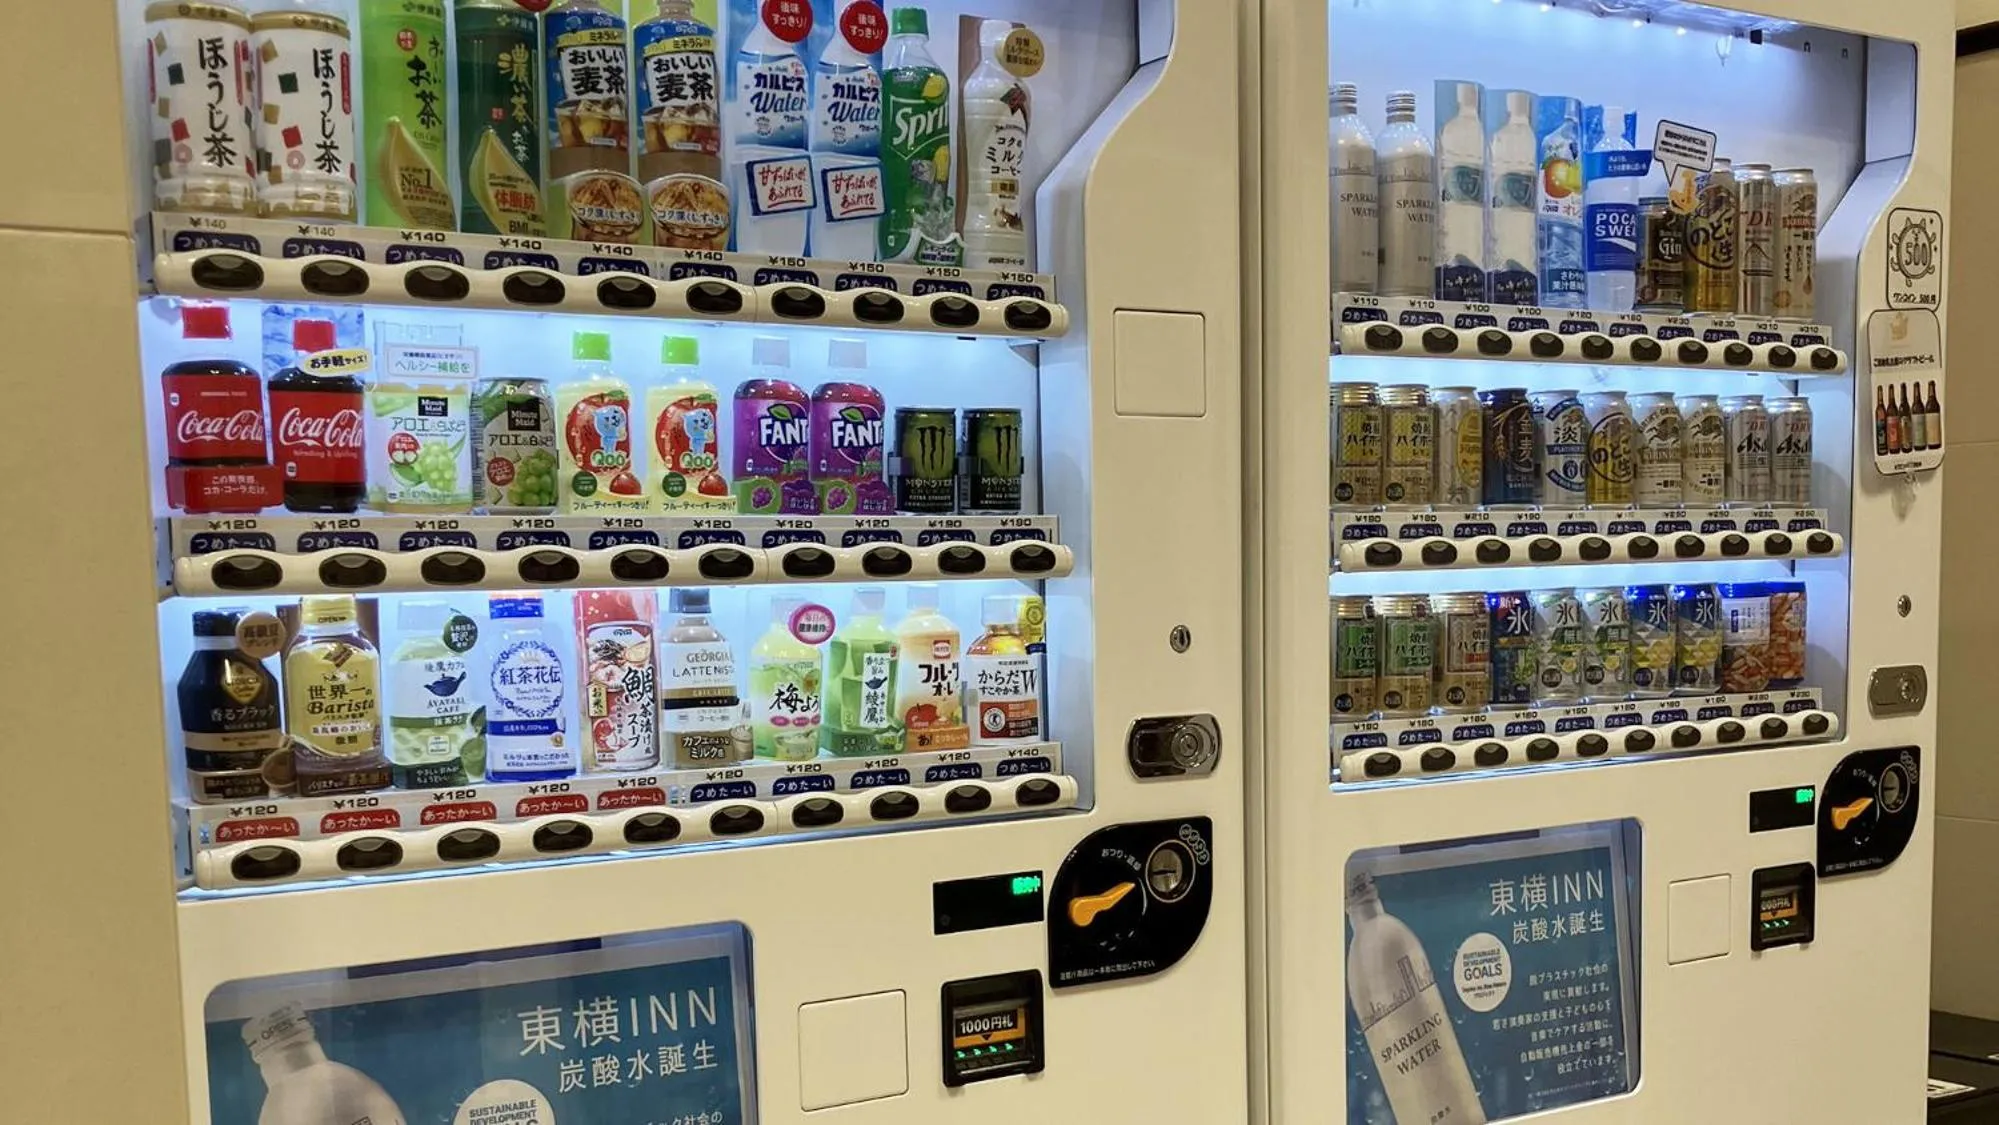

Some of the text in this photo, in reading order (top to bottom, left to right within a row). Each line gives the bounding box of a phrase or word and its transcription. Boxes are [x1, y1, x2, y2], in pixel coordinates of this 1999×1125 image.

[568, 49, 624, 65] おいしい
[653, 55, 712, 73] おいしい
[571, 65, 626, 97] 麦茶
[655, 72, 714, 103] 麦茶
[754, 72, 806, 93] カルピス
[405, 55, 443, 130] お茶
[832, 82, 880, 105] カルピス
[198, 37, 237, 168] ほうじ茶
[750, 91, 808, 115] Water
[312, 48, 342, 174] ほうじ茶
[828, 100, 880, 125] Water
[189, 216, 227, 231] ¥140
[297, 224, 336, 238] ¥140
[400, 230, 446, 243] ¥140
[499, 237, 542, 251] ¥140
[592, 243, 633, 256] ¥140
[684, 249, 723, 262] ¥140
[768, 254, 805, 268] ¥150
[848, 261, 885, 274] ¥150
[926, 266, 961, 279] ¥150
[1001, 271, 1034, 284] ¥150
[177, 409, 263, 444] Coca-Cola
[279, 407, 363, 448] Coca-Cola
[1518, 409, 1534, 463] 金麦
[592, 450, 626, 467] Qoo
[681, 452, 714, 469] Qoo
[905, 477, 952, 488] MONSTE
[208, 519, 257, 531] ¥120
[313, 519, 361, 531] ¥120
[415, 519, 459, 531] ¥120
[512, 518, 555, 530] ¥120
[603, 518, 643, 529] ¥120
[692, 518, 732, 530] ¥120
[775, 519, 813, 530] ¥120
[854, 519, 890, 529] ¥120
[499, 665, 563, 687] 紅茶花伝
[977, 668, 1020, 687] からだ
[1020, 668, 1038, 694] W
[307, 683, 373, 700] 世界一の
[978, 685, 1021, 697] すこやか茶
[306, 699, 375, 715] Barista
[864, 690, 879, 725] 綾鷹
[627, 713, 641, 748] スープ
[938, 751, 971, 762] ¥120
[1007, 748, 1040, 758] ¥140
[786, 762, 822, 774] ¥120
[863, 757, 899, 769] ¥120
[617, 776, 657, 789] ¥120
[705, 769, 744, 781] ¥120
[432, 788, 477, 802] ¥120
[528, 783, 570, 795] ¥120
[230, 804, 278, 817] ¥120
[333, 796, 379, 810] ¥120
[1489, 869, 1605, 917] 東横INN
[1512, 909, 1606, 945] 炭酸水誕生
[1463, 963, 1503, 982] GOALS
[516, 986, 718, 1057] 東横INN
[959, 1014, 1014, 1034] 1000円札
[1380, 1012, 1444, 1064] SPARKLING
[1396, 1038, 1443, 1077] WATER
[558, 1041, 719, 1094] 炭酸水誕生
[468, 1098, 537, 1118] SUSTAINABLE
